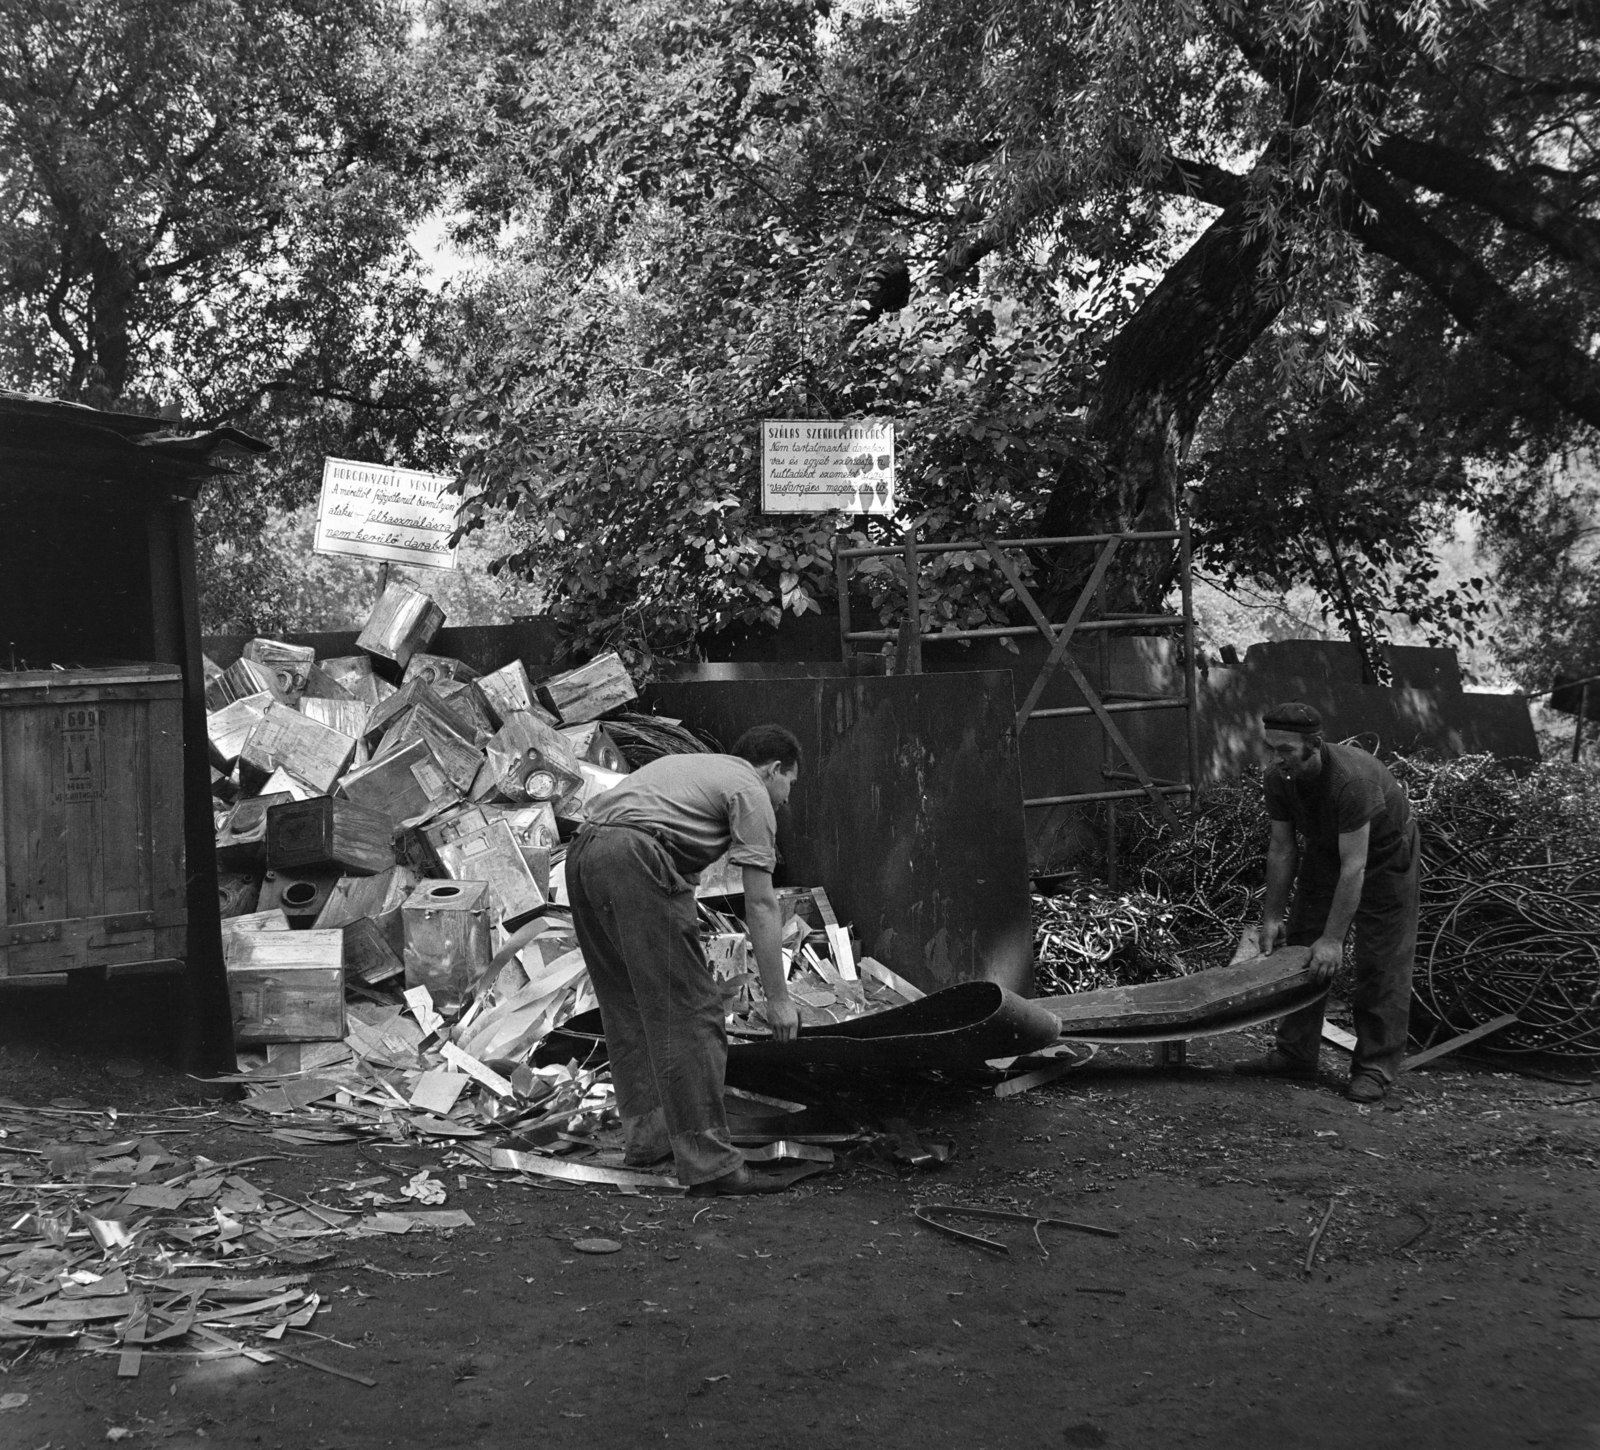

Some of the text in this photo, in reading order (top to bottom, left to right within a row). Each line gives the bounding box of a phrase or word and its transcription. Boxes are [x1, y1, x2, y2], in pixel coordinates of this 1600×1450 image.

[768, 425, 800, 438] SZÁLAS
[769, 441, 789, 453] Nem
[792, 441, 850, 453] tartalmazhat
[769, 457, 785, 466] vas
[789, 456, 798, 465] és
[803, 456, 830, 469] egyéb
[769, 468, 816, 479] hulladékot
[331, 483, 339, 494] A
[769, 481, 820, 497] vasforgács
[362, 509, 452, 532] felhasználásra
[326, 528, 351, 539] nem
